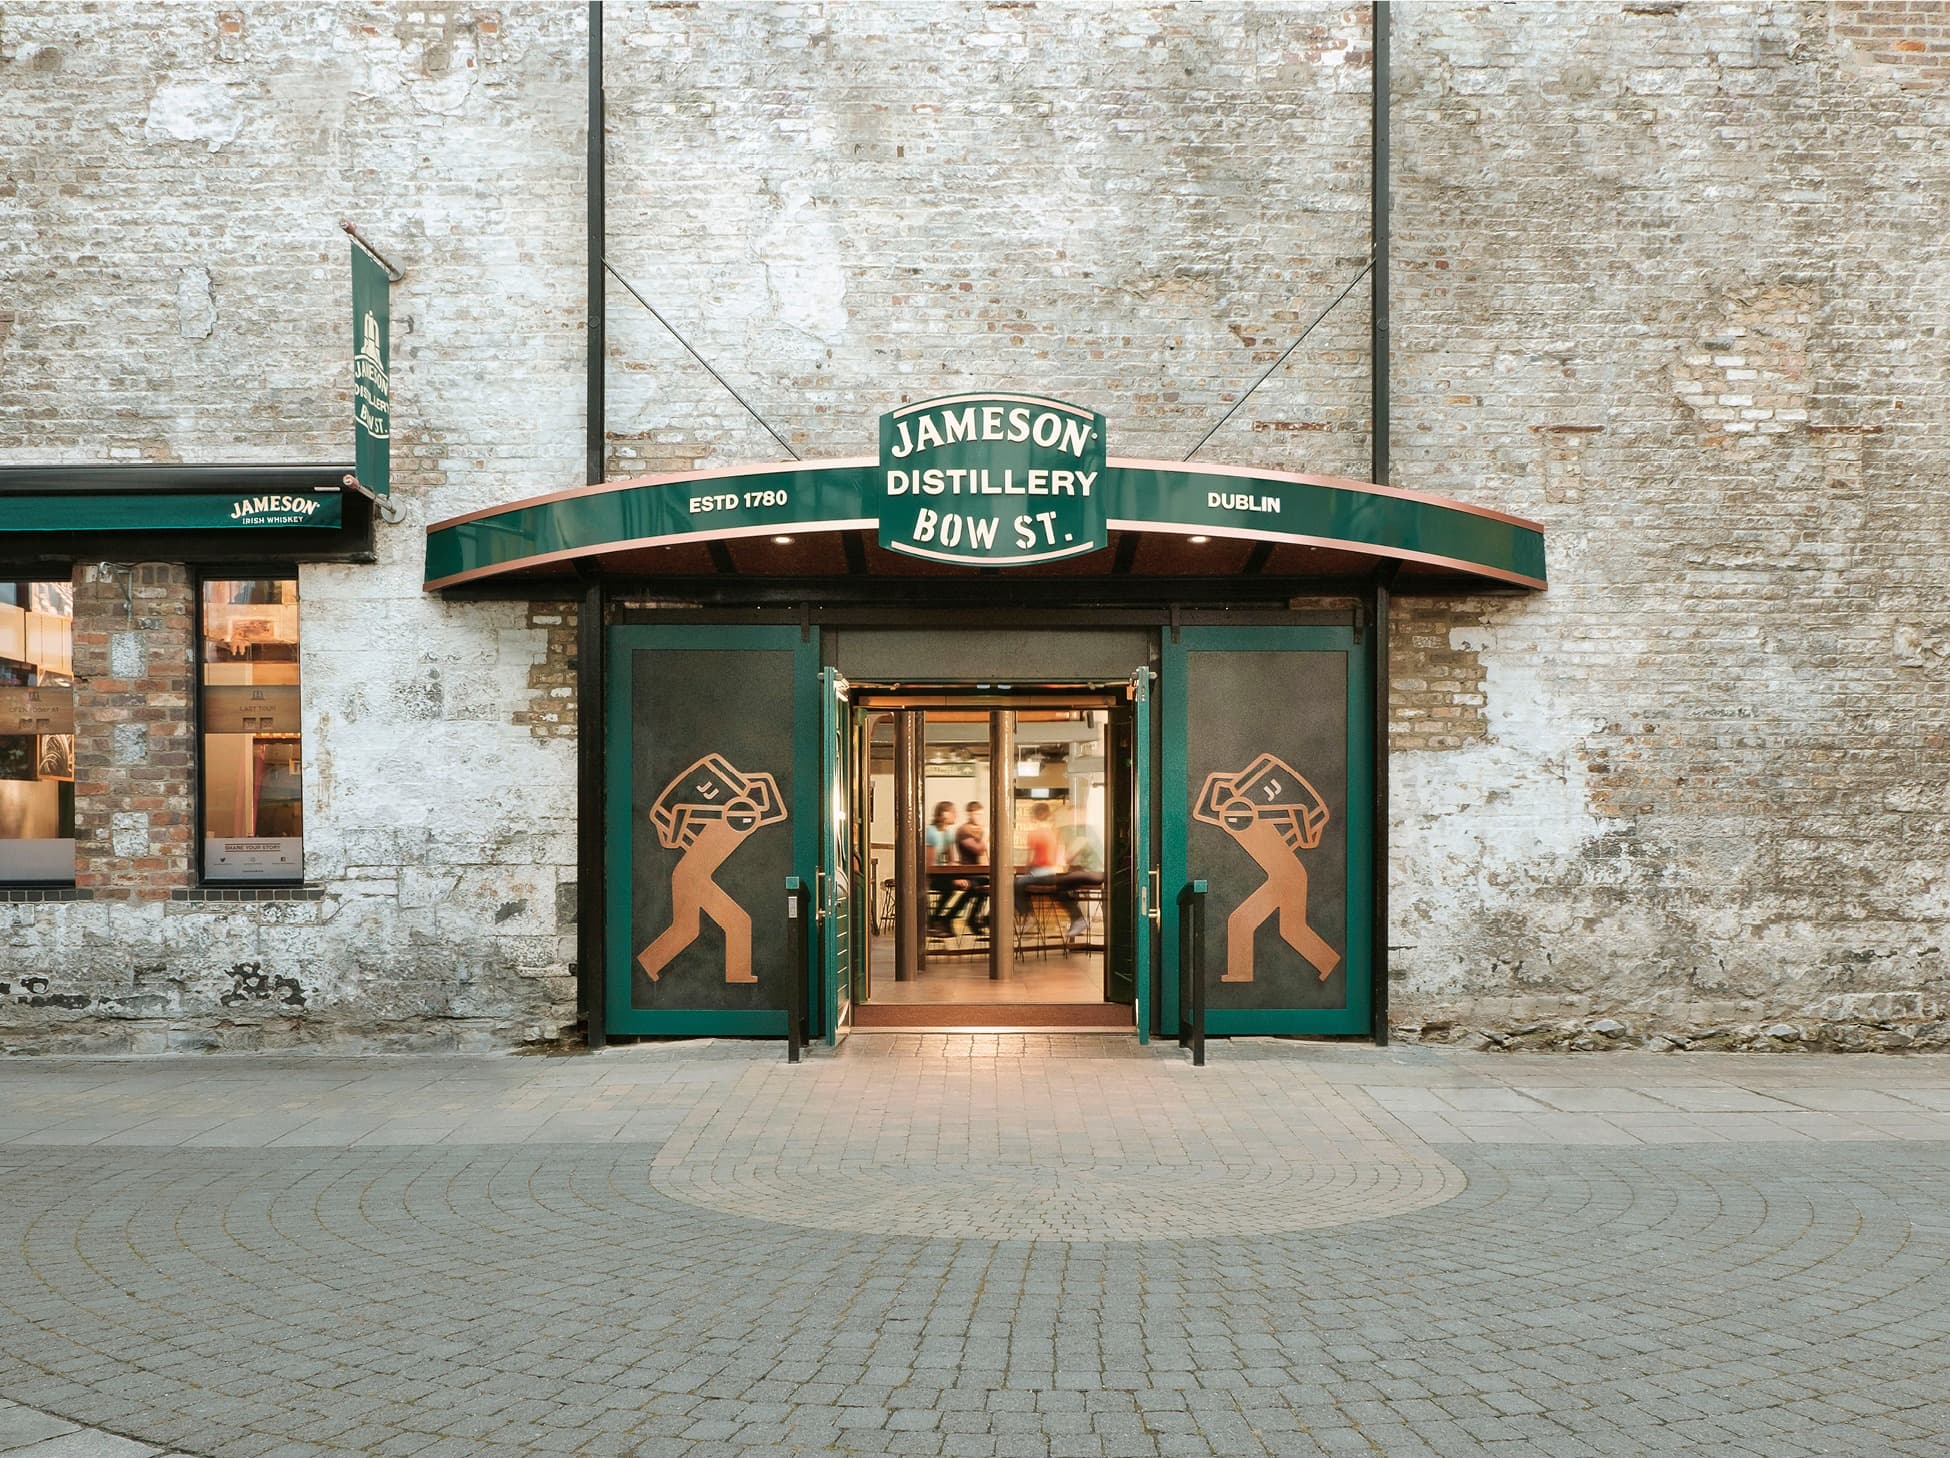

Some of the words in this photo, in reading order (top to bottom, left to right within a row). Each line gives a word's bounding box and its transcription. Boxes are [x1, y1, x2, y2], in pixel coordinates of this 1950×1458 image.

[354, 383, 389, 414] DISLLERY
[360, 404, 374, 430] BW
[374, 418, 388, 434] ST.
[891, 406, 1092, 458] JAMESON
[887, 469, 1098, 497] DISTILLERY
[230, 495, 318, 519] JAMESON
[689, 494, 739, 513] ESTD
[743, 490, 788, 508] 1780
[1207, 492, 1281, 514] DUBLIN
[242, 517, 265, 525] IRISH
[267, 516, 304, 524] WHISKEY
[912, 507, 1000, 550] BOW
[1013, 510, 1073, 550] ST.
[695, 780, 720, 800] JJ
[1263, 778, 1282, 802] JJ
